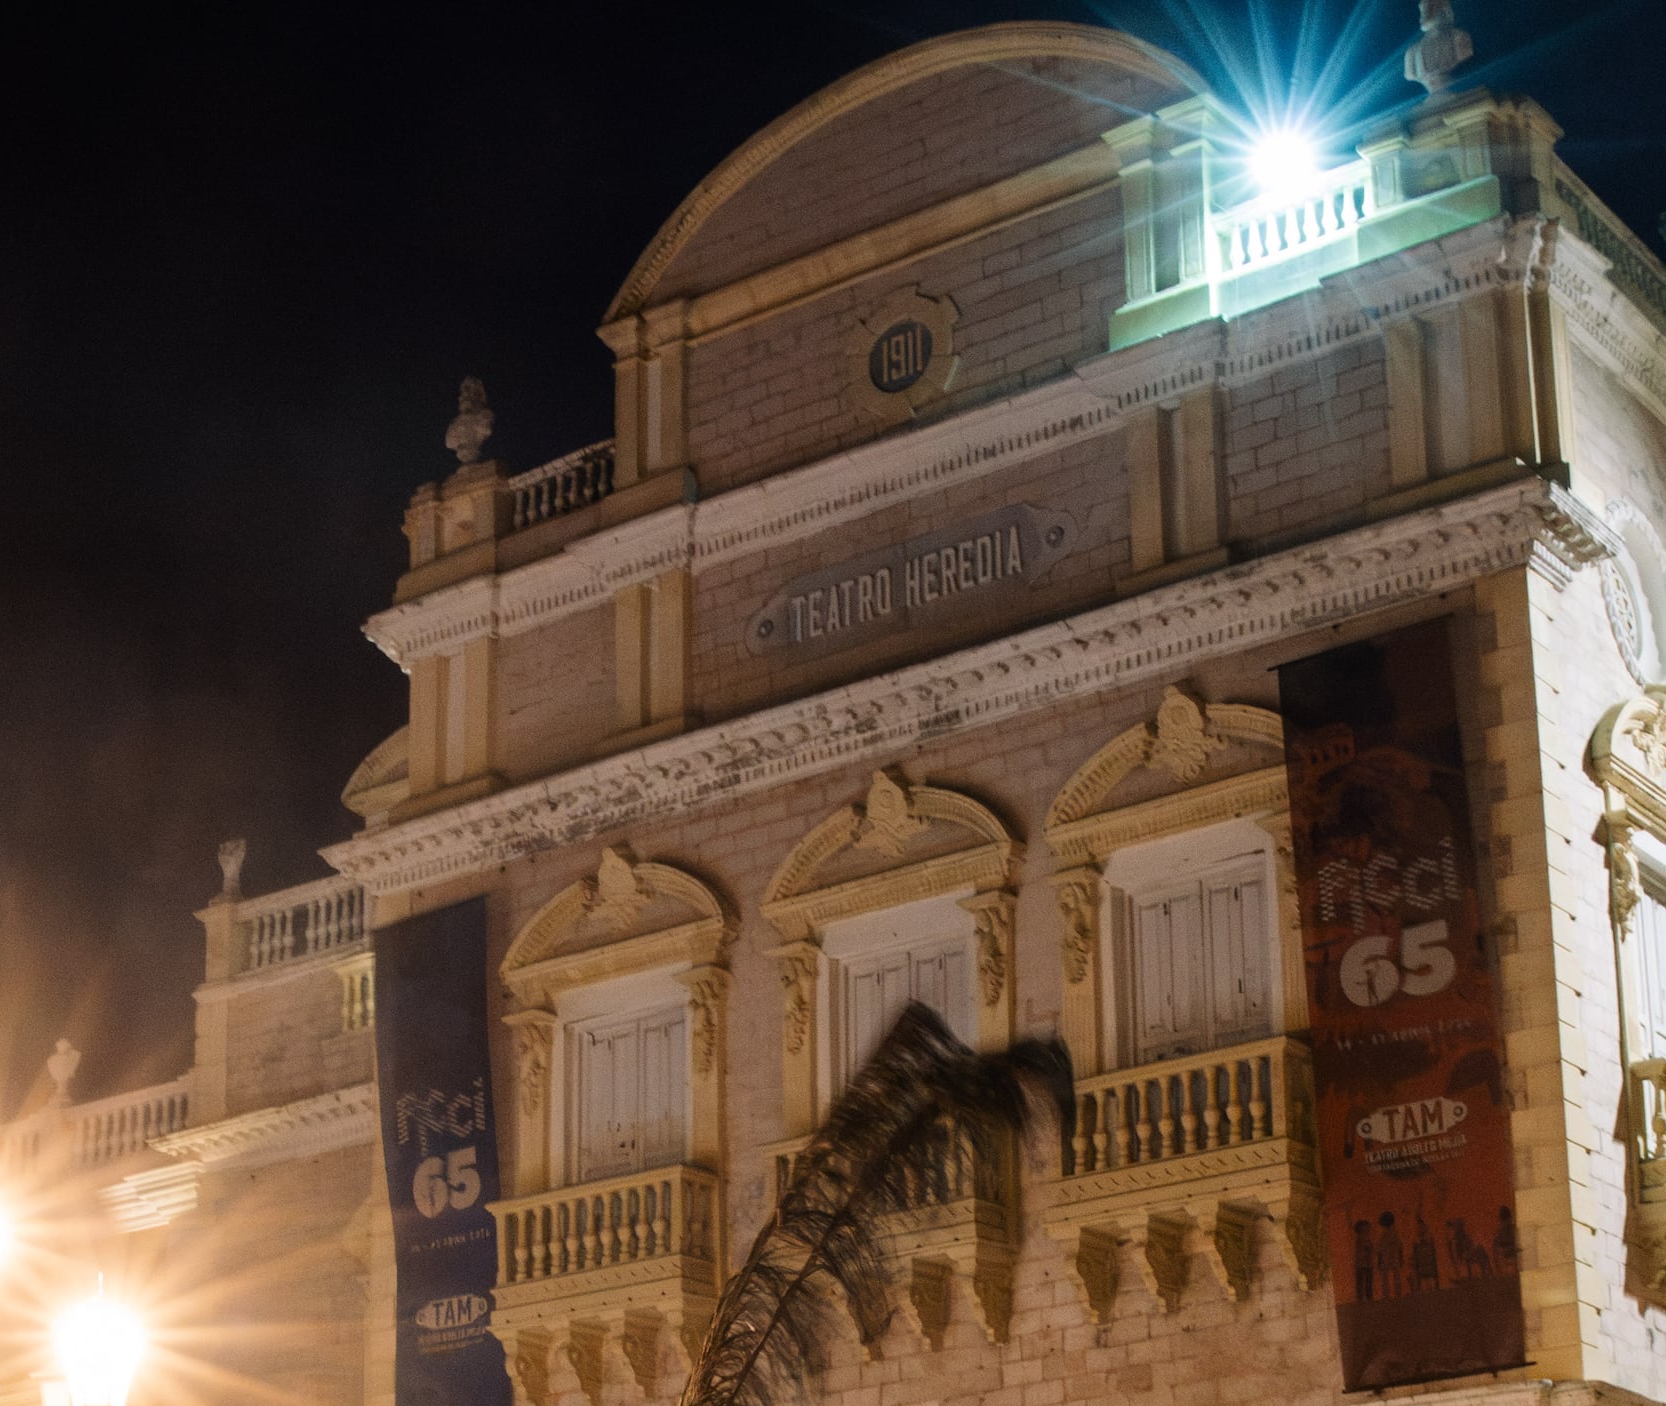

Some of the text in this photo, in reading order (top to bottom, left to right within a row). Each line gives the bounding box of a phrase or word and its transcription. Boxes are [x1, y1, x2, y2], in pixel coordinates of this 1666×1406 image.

[881, 326, 924, 384] 1911
[790, 525, 1024, 642] TEATRO HEREDIA
[1339, 919, 1457, 1008] 65
[1382, 1099, 1445, 1141] TAM
[412, 1146, 482, 1219] 65
[432, 1296, 472, 1327] TAM
